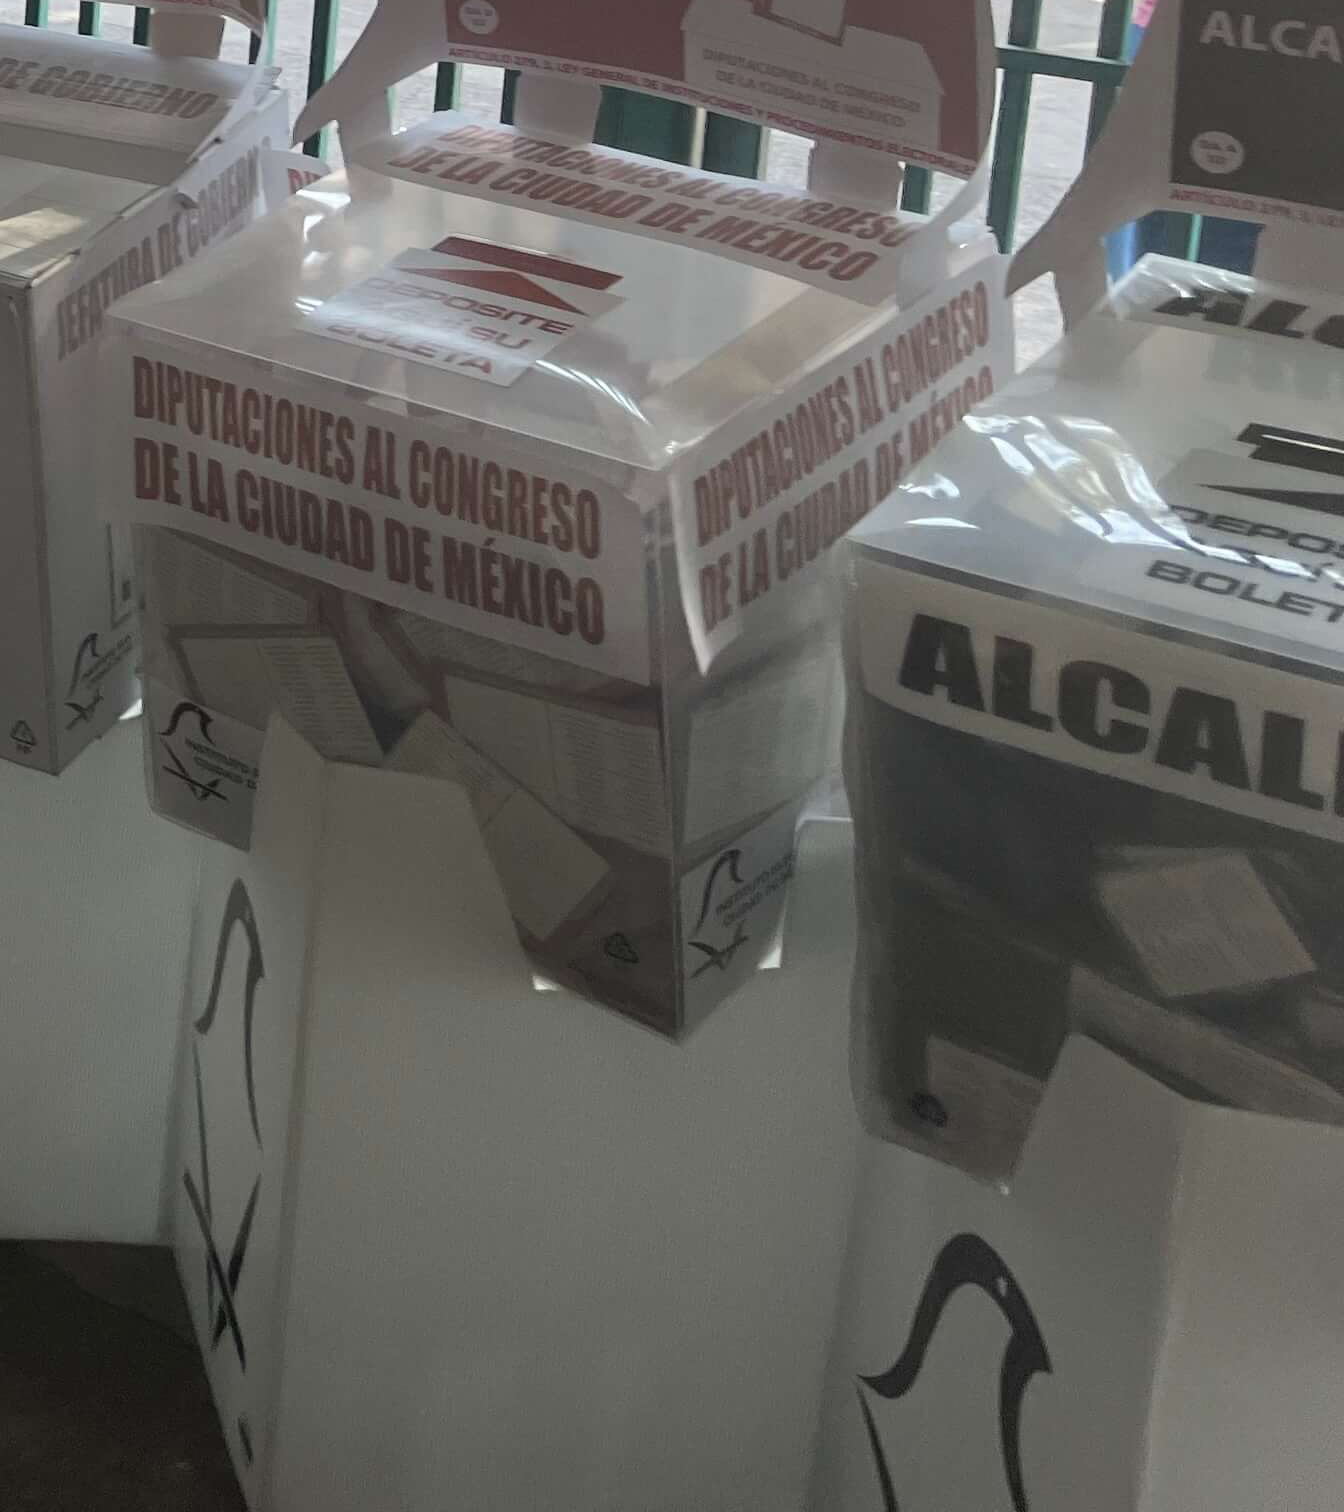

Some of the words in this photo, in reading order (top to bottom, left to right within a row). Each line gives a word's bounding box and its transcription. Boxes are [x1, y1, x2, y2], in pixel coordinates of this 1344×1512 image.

[0, 56, 43, 90] DE
[438, 123, 685, 196] DIPUTACIONES
[388, 144, 445, 175] DE
[440, 154, 489, 187] LA
[490, 164, 647, 221] CIUDAD
[638, 198, 713, 235] DE
[697, 212, 883, 282] MÉXICO
[131, 355, 356, 486] DIPUTACIONES
[361, 424, 402, 500] AL
[408, 437, 602, 561] CONGRESO
[694, 374, 855, 549] DIPUTACIONES
[853, 355, 884, 436] AL
[881, 280, 990, 414] CONGRESO
[132, 436, 180, 506] DE
[187, 450, 231, 524] LA
[235, 467, 376, 573] CIUDAD
[384, 516, 434, 593] DE
[441, 534, 606, 647] MÉXICO
[698, 551, 732, 634] DE
[737, 527, 771, 608] LA
[775, 457, 870, 582] CIUDAD
[898, 612, 1344, 821] ALCAL
